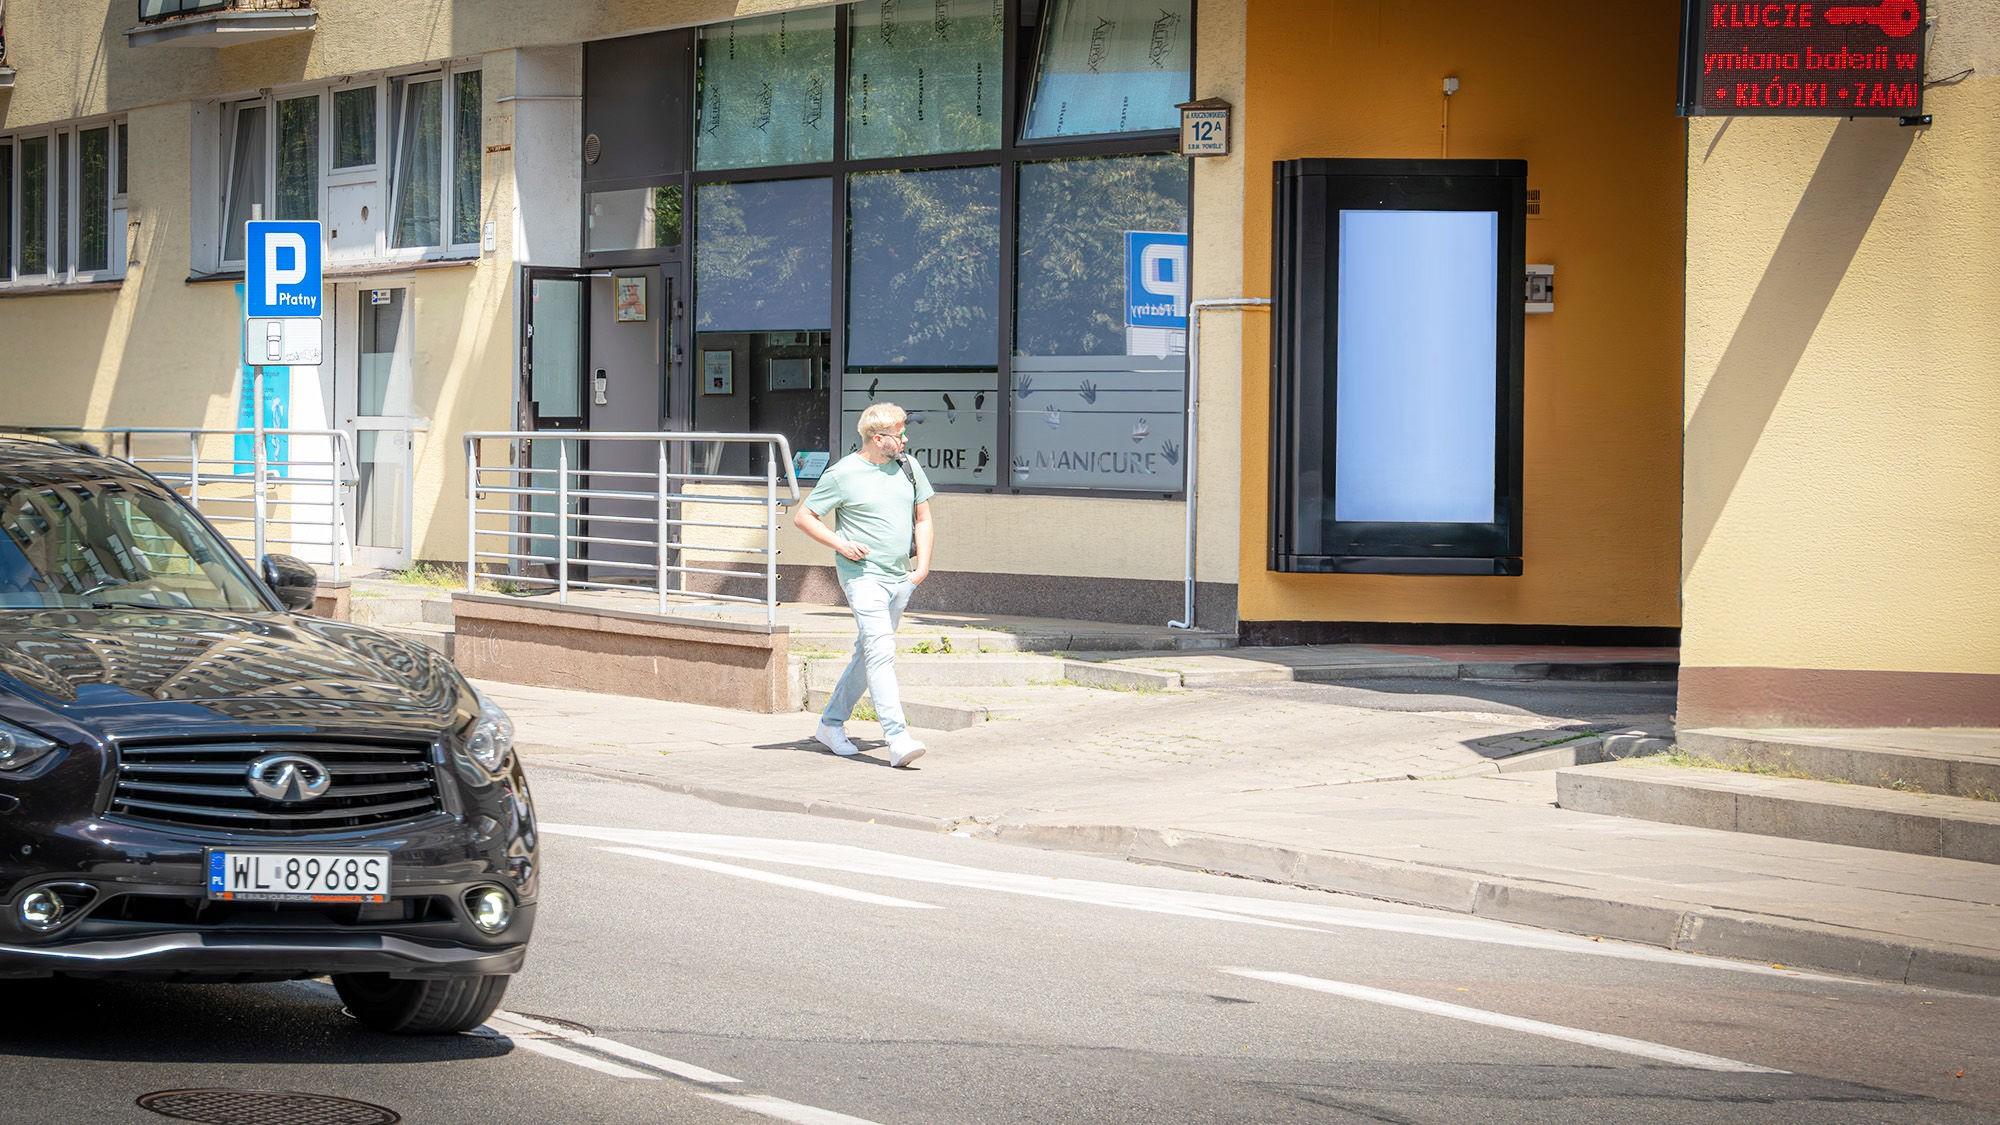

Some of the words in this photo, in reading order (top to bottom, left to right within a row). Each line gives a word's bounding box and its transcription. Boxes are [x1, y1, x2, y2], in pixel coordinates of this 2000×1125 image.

[1711, 4, 1813, 28] KLUCZE
[1806, 46, 1887, 70] baterii
[1736, 76, 1827, 107] KŁÓDKI
[265, 232, 306, 305] P
[279, 292, 317, 309] Płatny
[1035, 450, 1157, 475] MANICURE
[212, 876, 223, 886] PL
[233, 856, 270, 889] WL
[286, 858, 380, 891] 8968S
